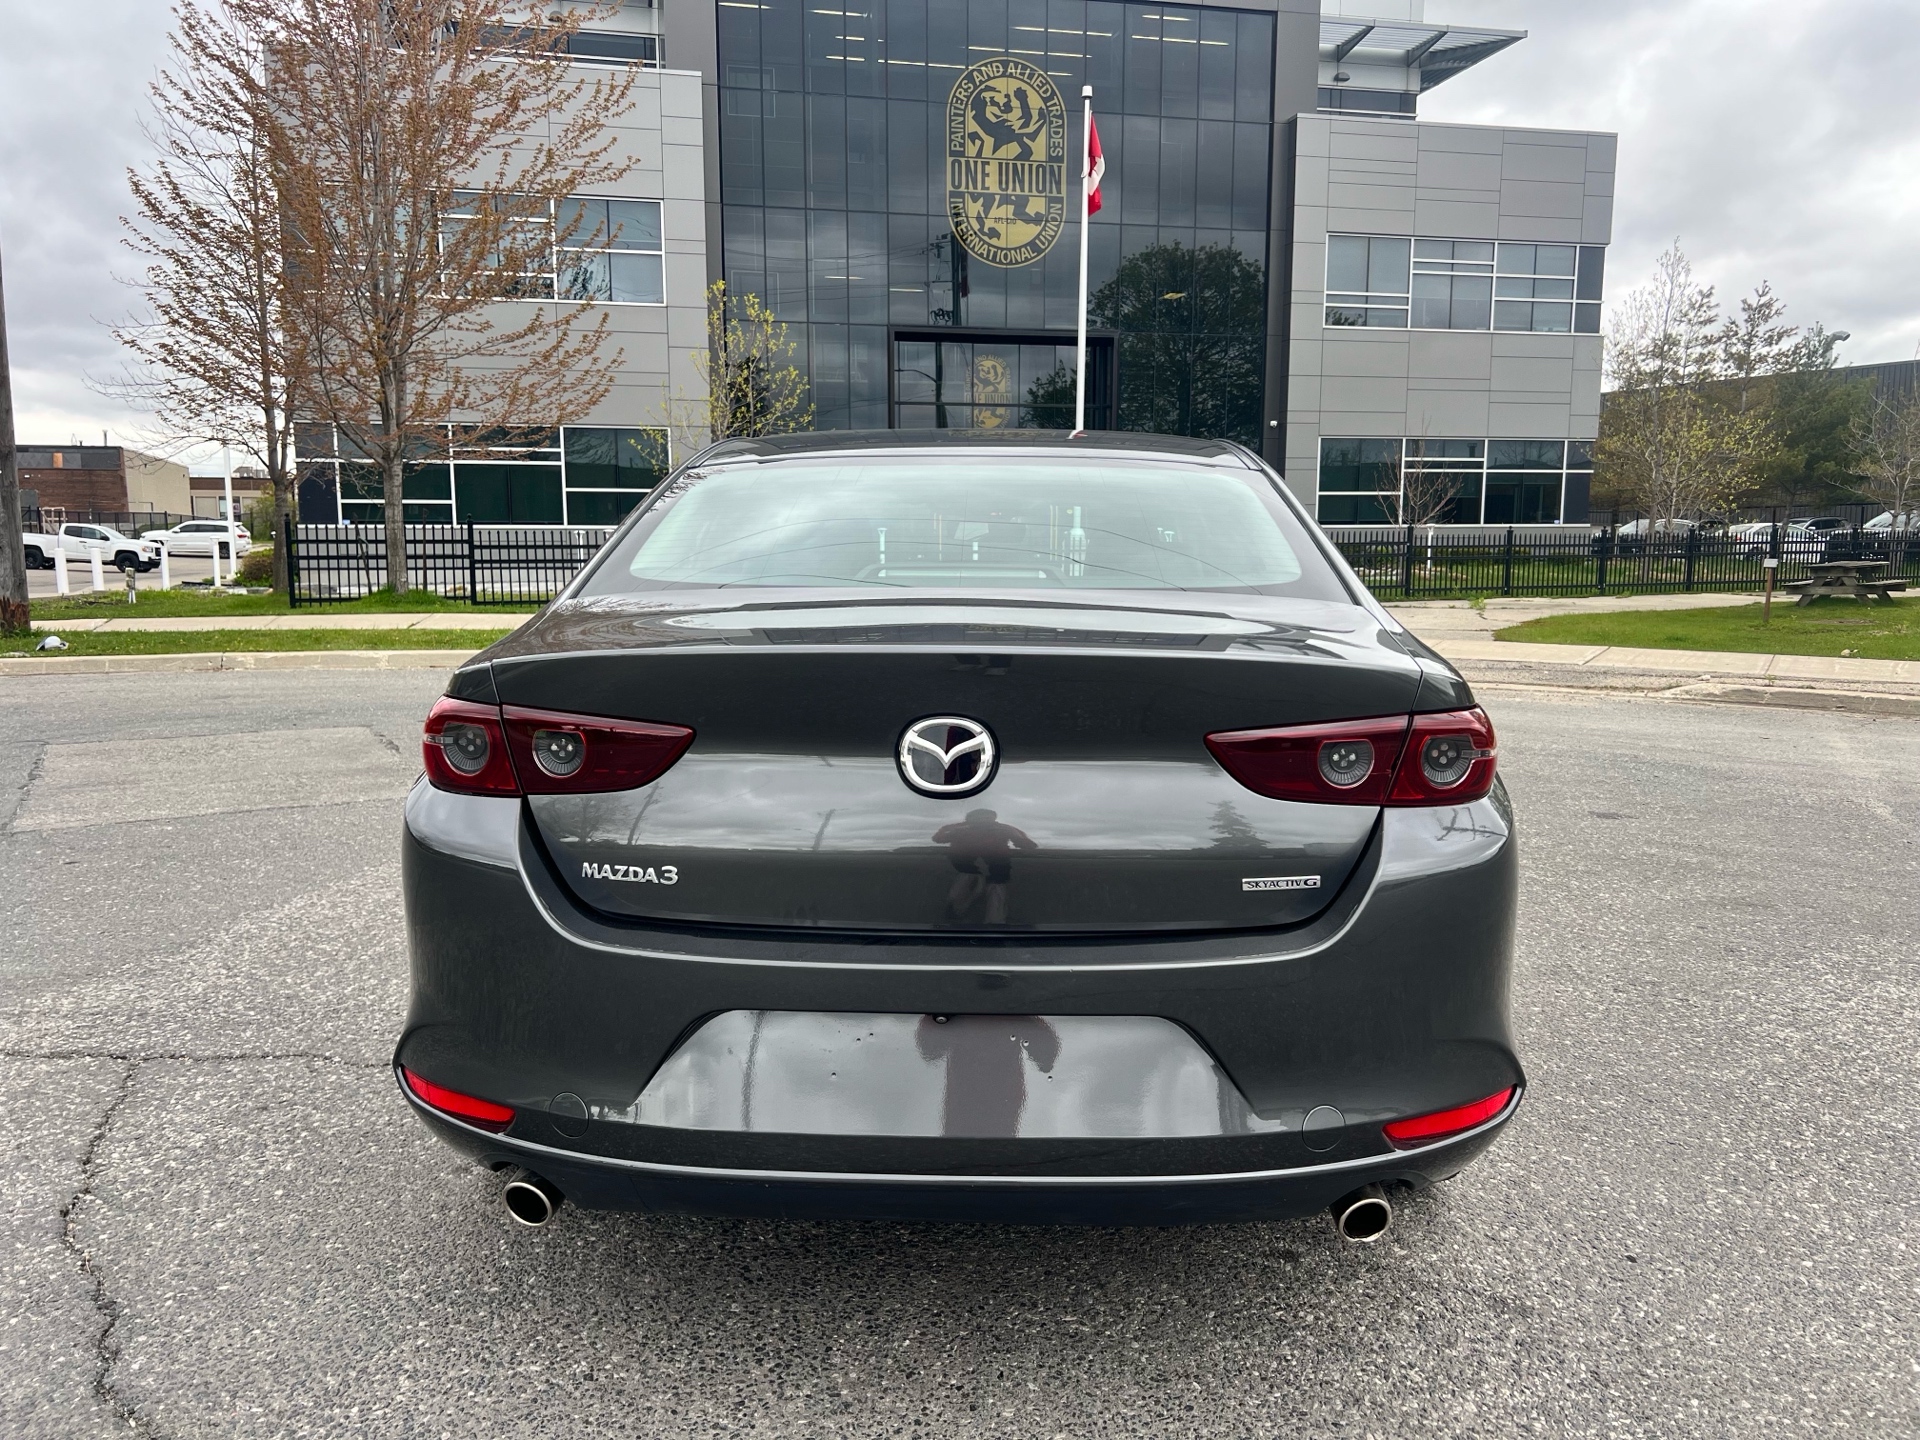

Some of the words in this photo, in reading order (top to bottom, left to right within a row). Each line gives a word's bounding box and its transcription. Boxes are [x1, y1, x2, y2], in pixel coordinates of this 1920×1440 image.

[951, 79, 974, 151] PAINTERS
[973, 62, 1004, 84] AND
[1007, 62, 1052, 98] ALLIED
[1046, 95, 1063, 157] TRADES
[951, 158, 991, 191] ONE
[999, 162, 1063, 195] UNION
[950, 198, 1038, 264] INTERNATIONAL
[1035, 203, 1063, 250] UNION
